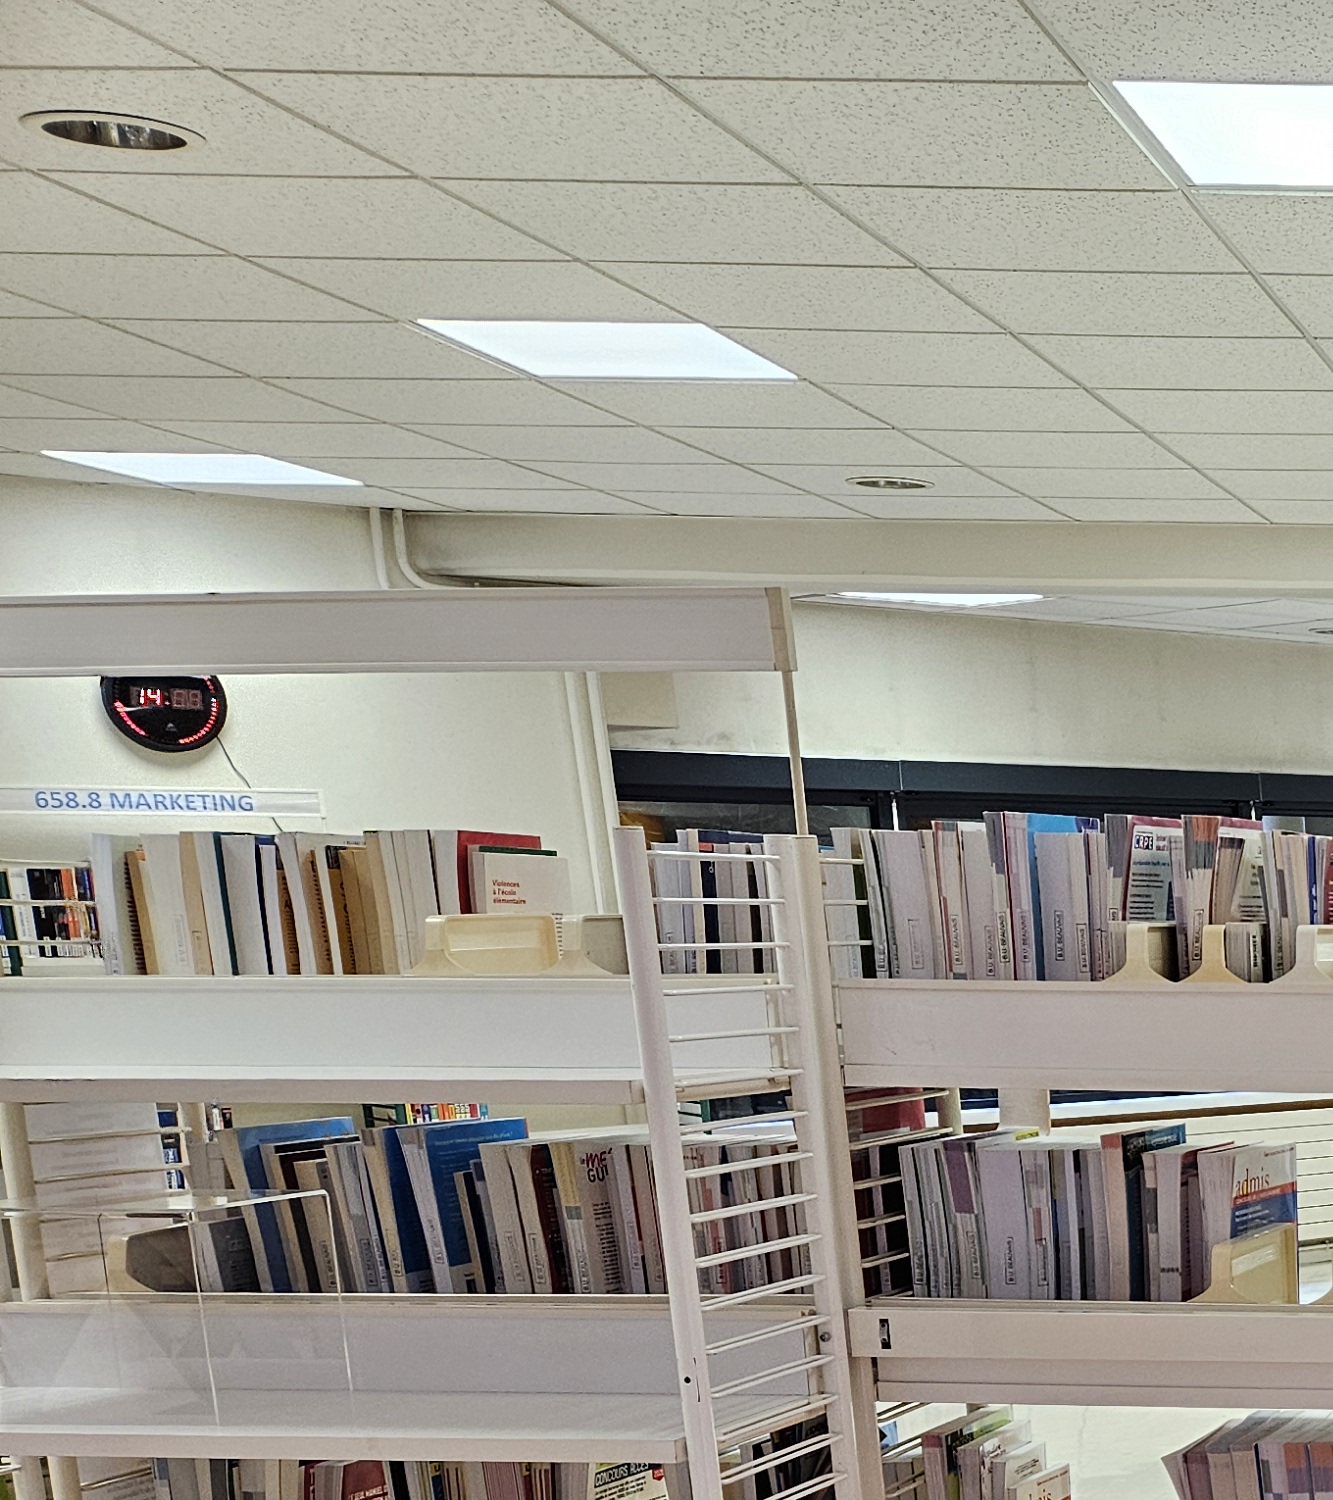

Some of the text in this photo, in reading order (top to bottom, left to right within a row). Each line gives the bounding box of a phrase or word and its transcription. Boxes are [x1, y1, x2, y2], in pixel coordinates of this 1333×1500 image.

[34, 791, 254, 812] 658.8 MARKETING
[492, 879, 520, 888] Violences
[1236, 1167, 1270, 1196] admis
